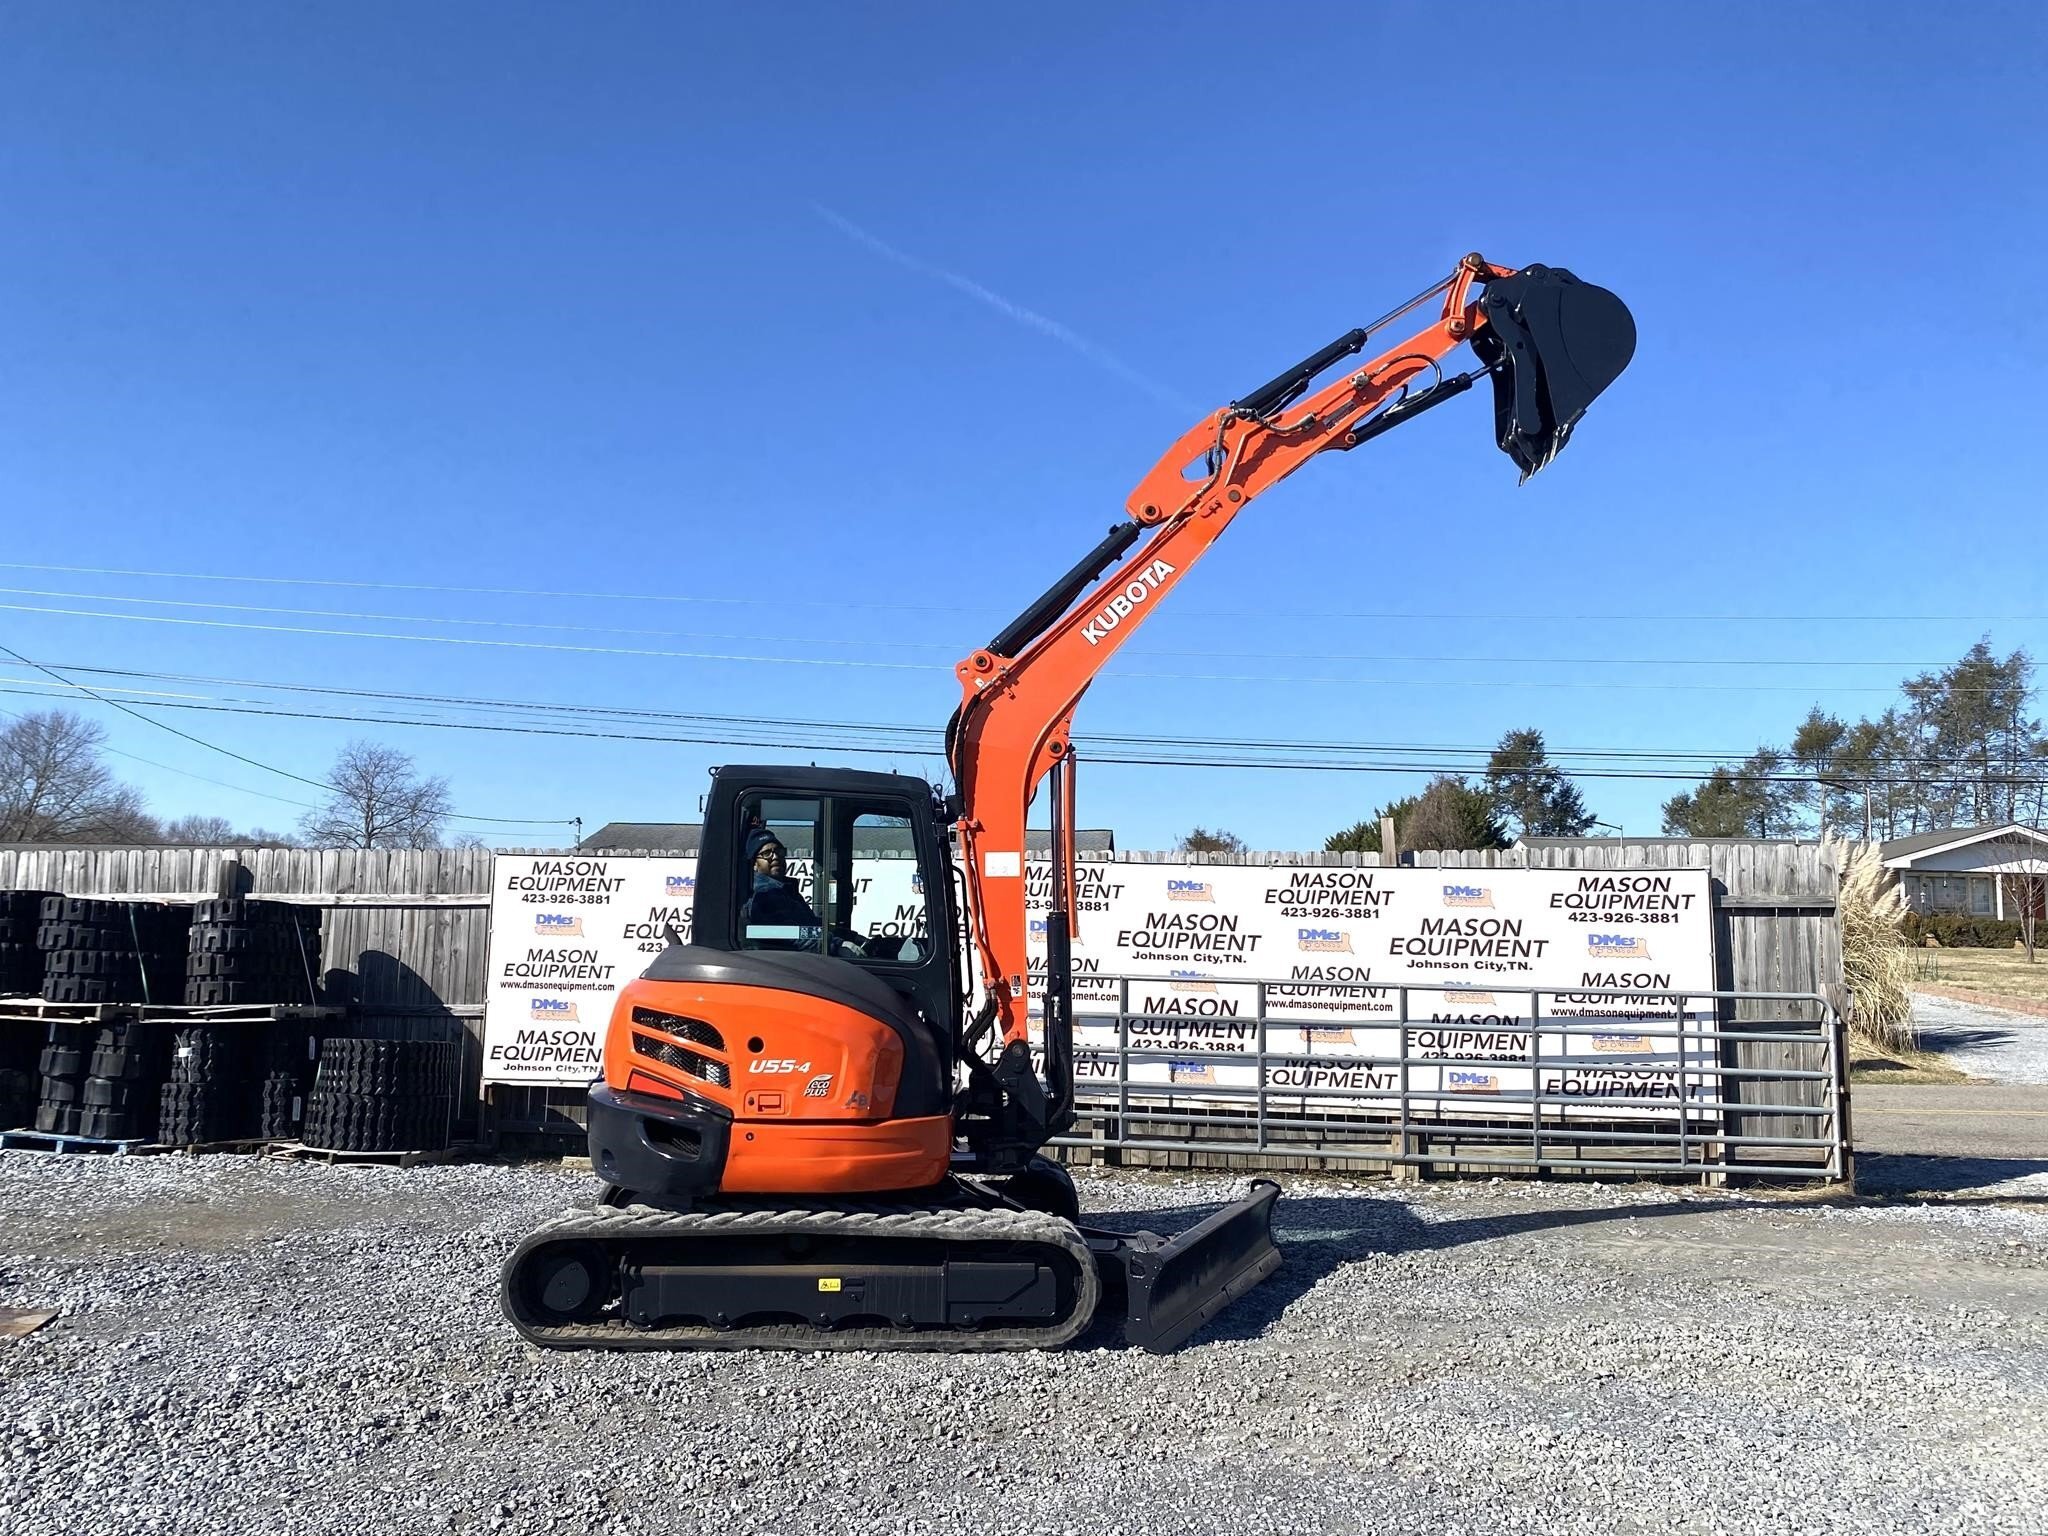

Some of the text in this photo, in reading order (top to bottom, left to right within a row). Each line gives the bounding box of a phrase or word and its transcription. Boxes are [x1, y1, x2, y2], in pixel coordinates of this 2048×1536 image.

[1080, 559, 1177, 647] KUBOTA
[531, 861, 607, 876] MASON
[1024, 866, 1105, 882] MAON
[507, 876, 625, 892] EQUIPMENT
[1290, 872, 1374, 889] MASON
[1577, 877, 1671, 893] MASON
[521, 893, 610, 904] 423-926-3881
[1264, 889, 1395, 906] EQUIPMENT
[1549, 893, 1695, 910] EQUIPMENT
[648, 906, 694, 923] MAS
[1281, 907, 1380, 919] 423-926-3881
[1568, 912, 1679, 923] 423-926-3881
[1145, 912, 1239, 932] MASON
[1420, 918, 1522, 937] MASON
[1116, 930, 1262, 951] EQUIPMENT
[1389, 937, 1549, 958] EQUIPMENT
[526, 948, 598, 963] MASON
[1132, 951, 1188, 961] Johnson
[503, 963, 615, 979] EQUIPMENT
[1026, 957, 1099, 972] MAON
[1406, 959, 1469, 969] Johnson
[1291, 966, 1371, 981] MASON
[1581, 972, 1671, 988] MASON
[500, 980, 615, 992] www.dmasonequipment.com
[1143, 996, 1239, 1017] MASON
[516, 1030, 596, 1046] MASON
[490, 1045, 602, 1062] EQUIPMEN
[503, 1063, 598, 1074] Johnson City,TN
[803, 1088, 829, 1097] PLUS
